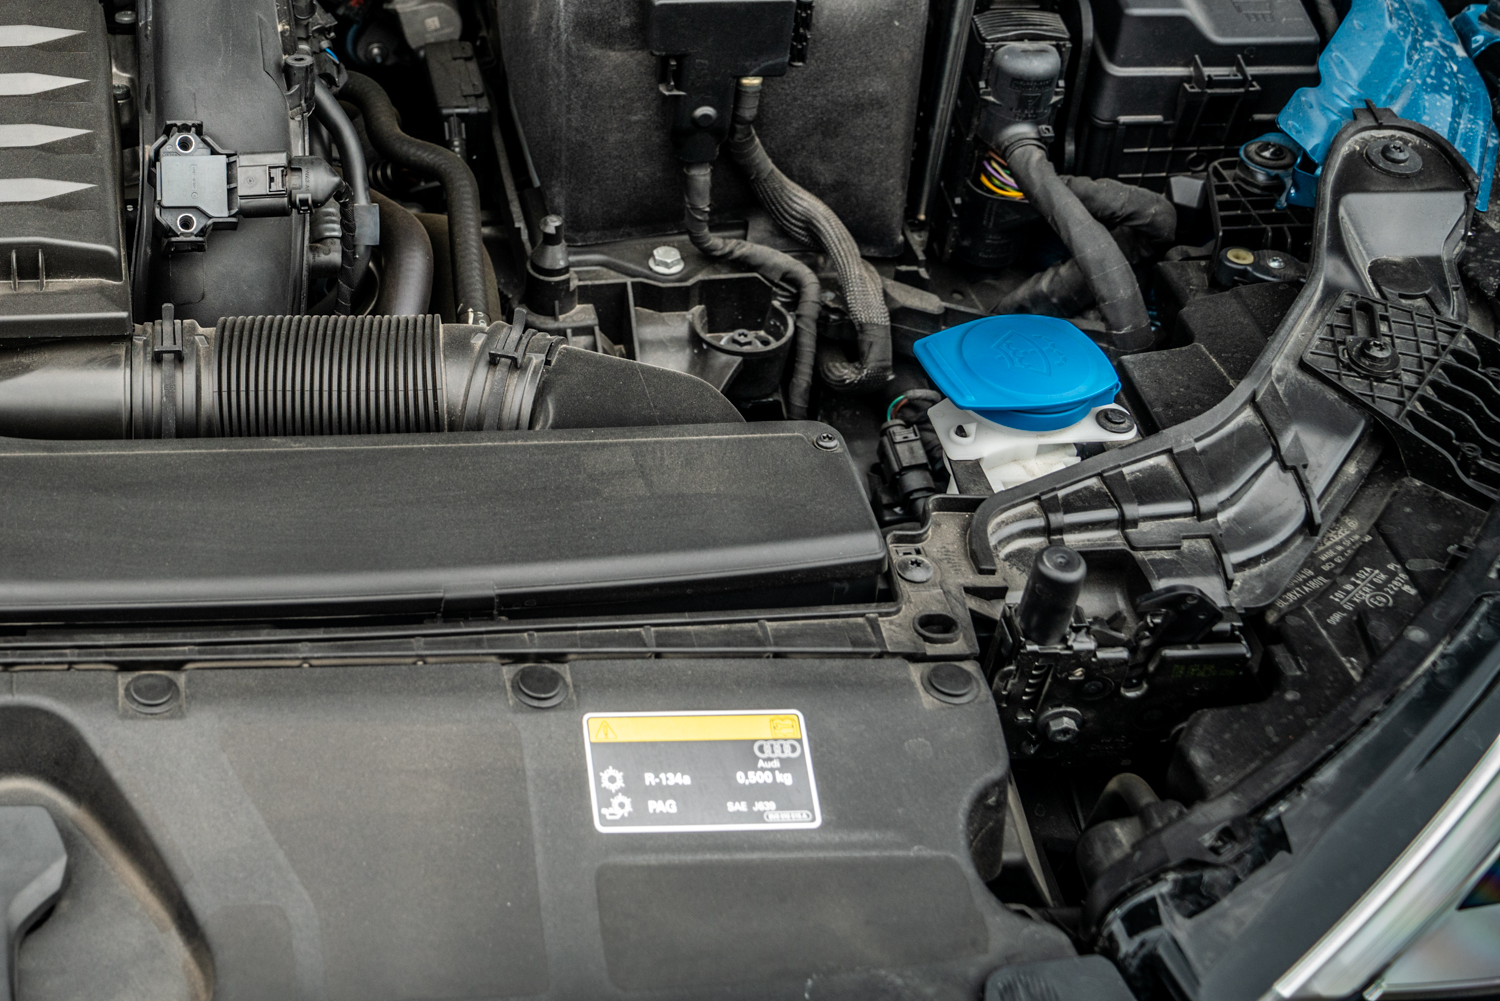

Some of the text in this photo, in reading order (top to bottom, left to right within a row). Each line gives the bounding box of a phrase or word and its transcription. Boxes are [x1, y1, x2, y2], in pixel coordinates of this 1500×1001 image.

[1318, 548, 1337, 562] MADE
[757, 758, 780, 769] Audi
[644, 771, 793, 786] R-134a 0,500 kg
[647, 799, 677, 813] PAG
[726, 801, 748, 812] SAE
